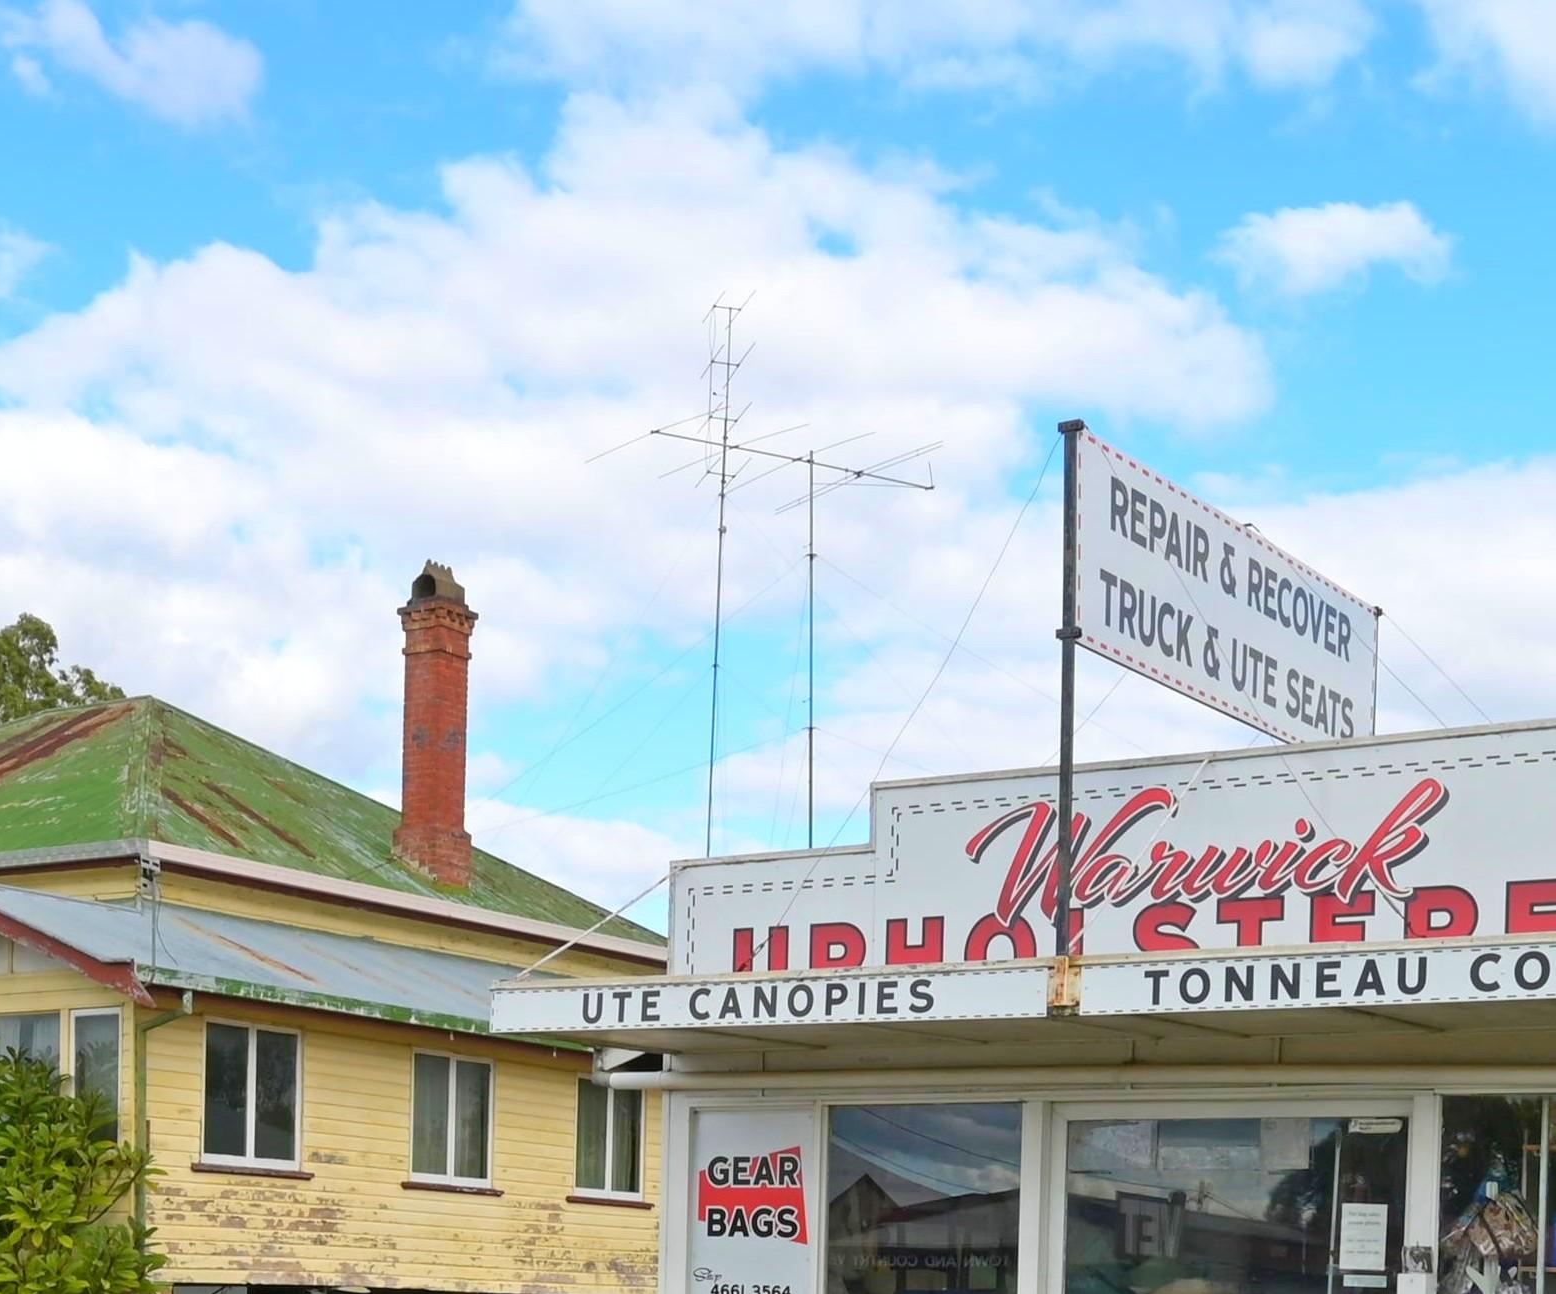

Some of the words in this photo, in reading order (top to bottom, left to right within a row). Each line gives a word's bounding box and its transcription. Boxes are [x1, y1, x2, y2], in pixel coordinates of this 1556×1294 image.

[1110, 475, 1209, 583] REPAIR
[1220, 542, 1238, 599] &
[1247, 556, 1352, 663] RECOVER
[1100, 567, 1194, 668] TRUCK
[1202, 624, 1221, 682] &
[1231, 638, 1278, 709] UTE
[1285, 667, 1355, 739] SEATS
[965, 777, 1451, 929] Warwick
[581, 989, 661, 1026] UTE
[688, 978, 935, 1022] CANOPIES
[1144, 954, 1428, 1006] TONNEAU
[706, 1155, 800, 1187] GEAR
[705, 1207, 798, 1240] BAGS
